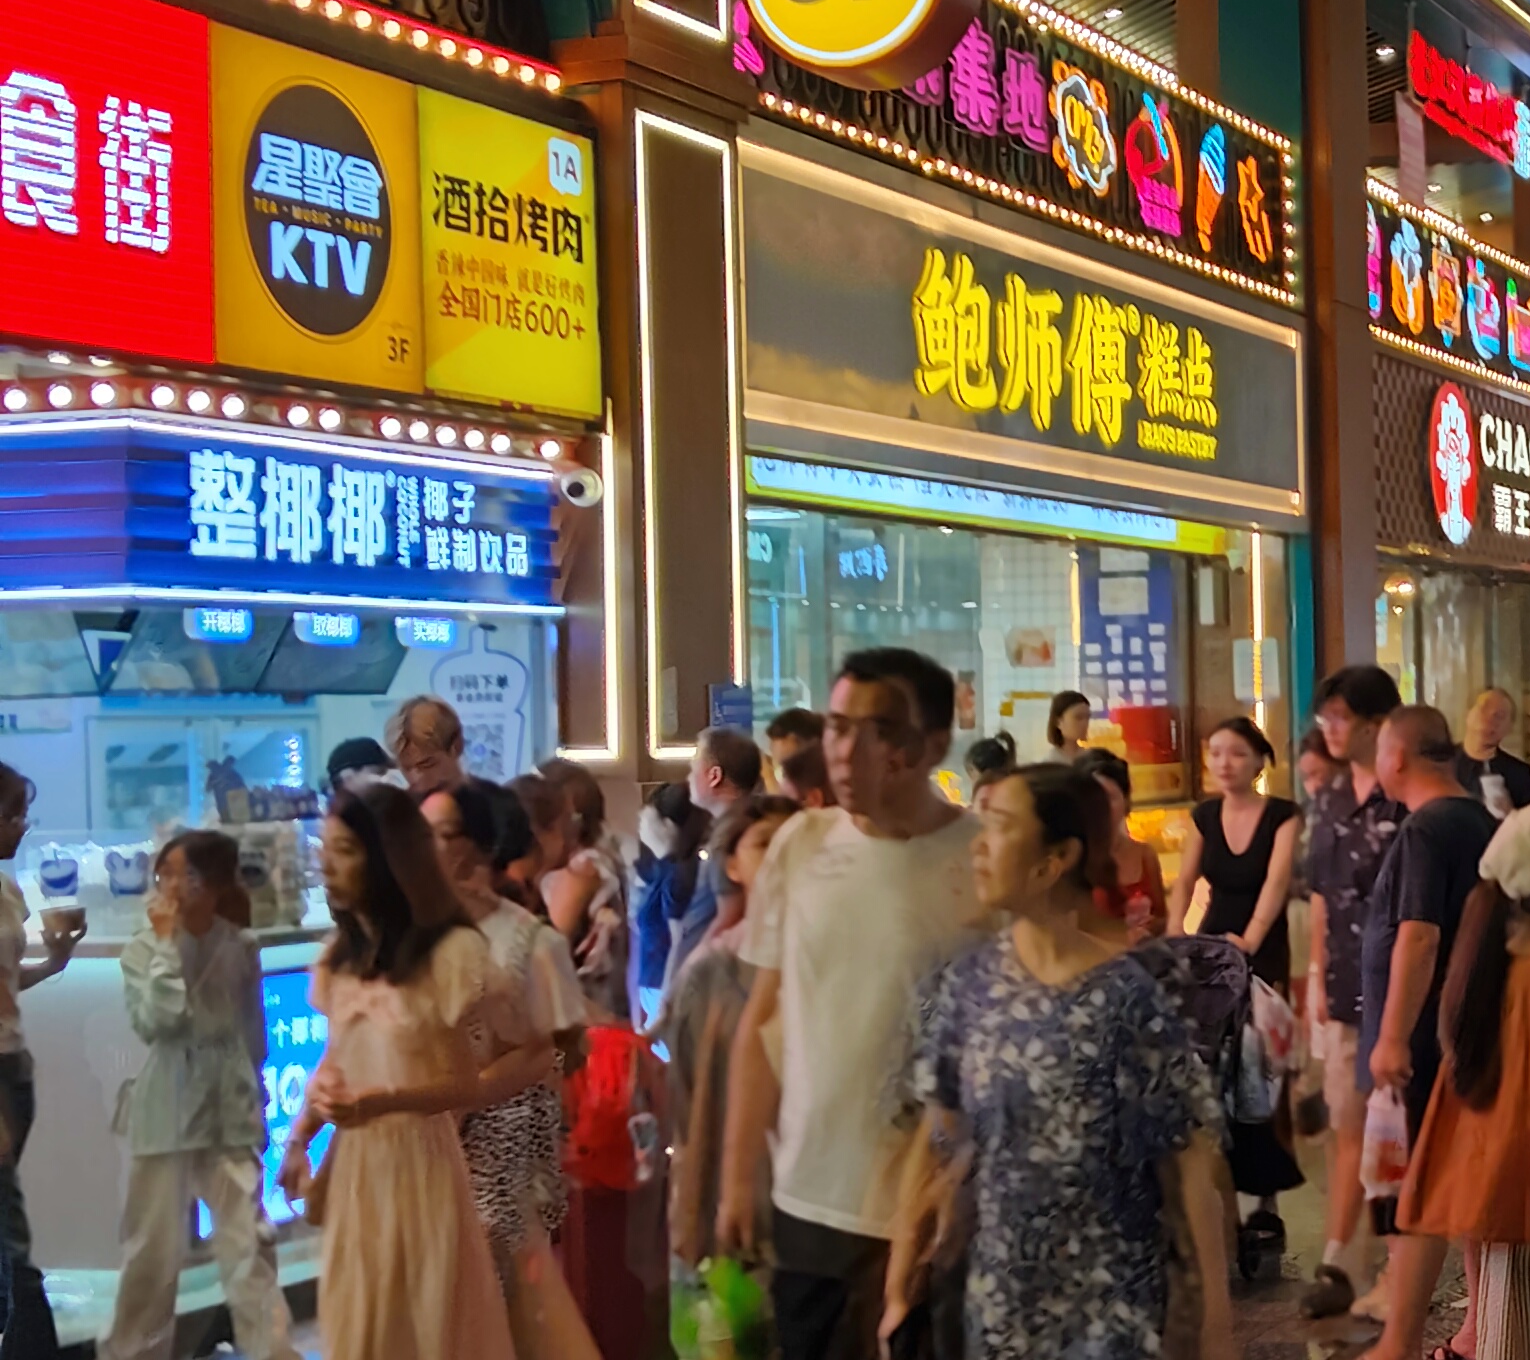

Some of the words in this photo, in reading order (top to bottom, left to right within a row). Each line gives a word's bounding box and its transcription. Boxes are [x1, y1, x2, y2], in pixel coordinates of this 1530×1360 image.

[251, 132, 384, 220] 星聚會
[551, 150, 580, 185] 1A
[291, 204, 333, 228] MUSIC
[343, 216, 385, 240] PARTY
[432, 168, 585, 265] 酒拾烤肉
[268, 220, 373, 297] KTV
[438, 279, 588, 341] 全国门店600+
[387, 334, 412, 366] 3F
[913, 247, 1134, 446] 鲍师傅
[1136, 312, 1219, 429] 糕点
[188, 449, 388, 568] 整椰椰
[422, 475, 477, 525] 椰子
[423, 524, 529, 578] 鲜制饮品
